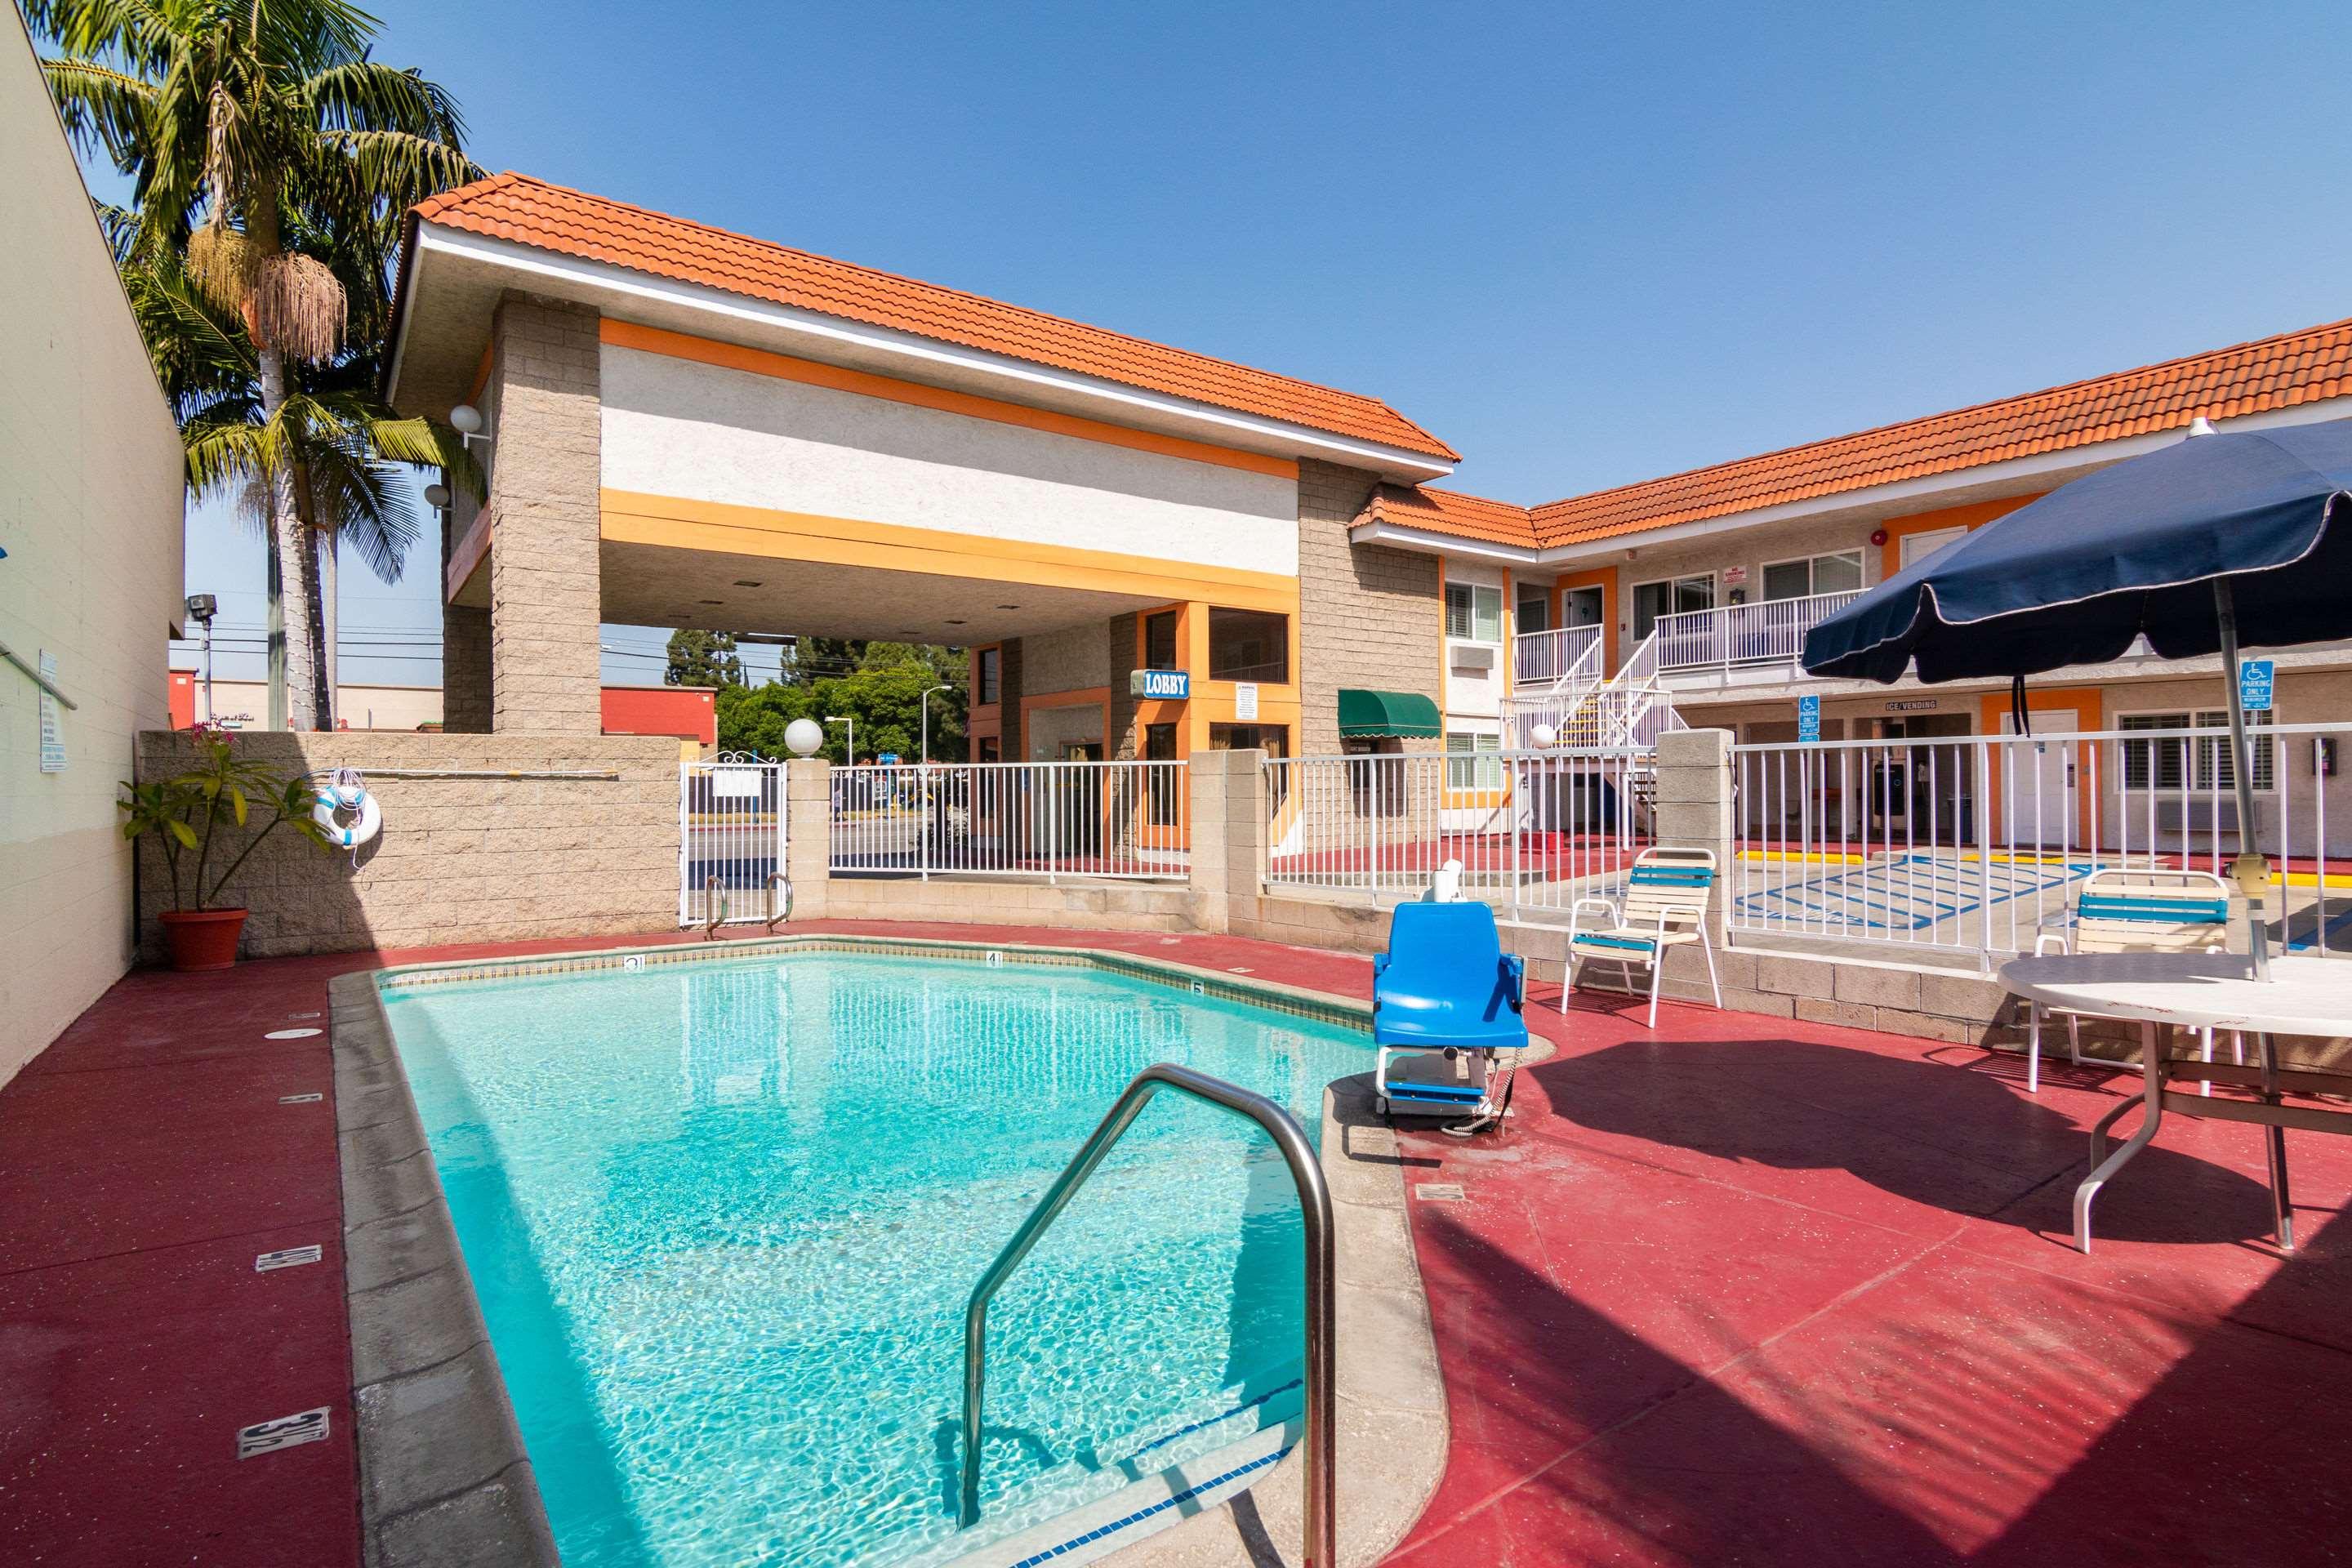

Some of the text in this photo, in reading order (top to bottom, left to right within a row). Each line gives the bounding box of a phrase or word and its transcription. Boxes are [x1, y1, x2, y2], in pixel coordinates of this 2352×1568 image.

[1146, 674, 1187, 695] LOBBY
[1886, 701, 1936, 710] ICE/VENDING
[1193, 982, 1201, 994] 5
